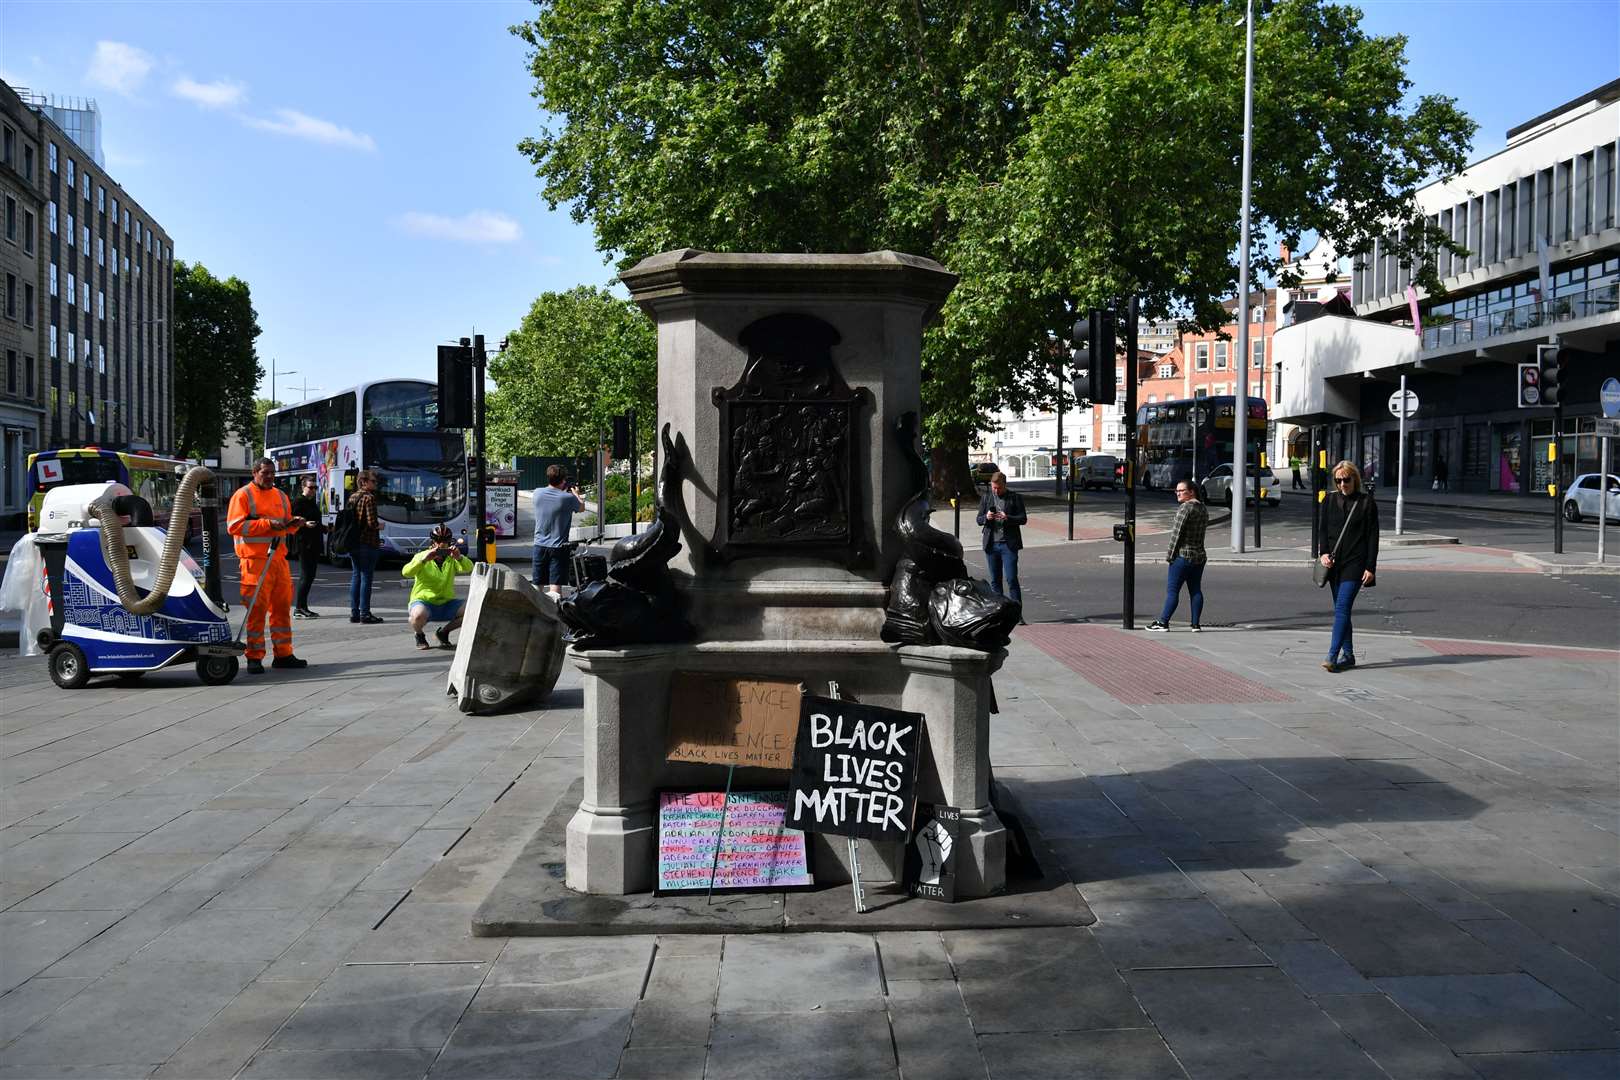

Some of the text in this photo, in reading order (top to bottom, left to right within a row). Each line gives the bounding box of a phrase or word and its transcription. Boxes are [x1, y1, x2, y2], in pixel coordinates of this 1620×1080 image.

[43, 464, 57, 478] L
[202, 530, 210, 567] MV2000
[810, 713, 913, 757] BLACK
[675, 747, 781, 762] BLACK LIVES MATTER
[823, 753, 904, 792] LIVES
[663, 793, 693, 806] THE
[697, 793, 723, 807] UK
[793, 786, 907, 831] MATTER
[939, 810, 960, 821] LIVES
[664, 830, 705, 838] ADRIAN
[663, 861, 696, 871] JULIAN
[663, 870, 705, 880] STEPHEN
[665, 879, 711, 888] MICHAEL
